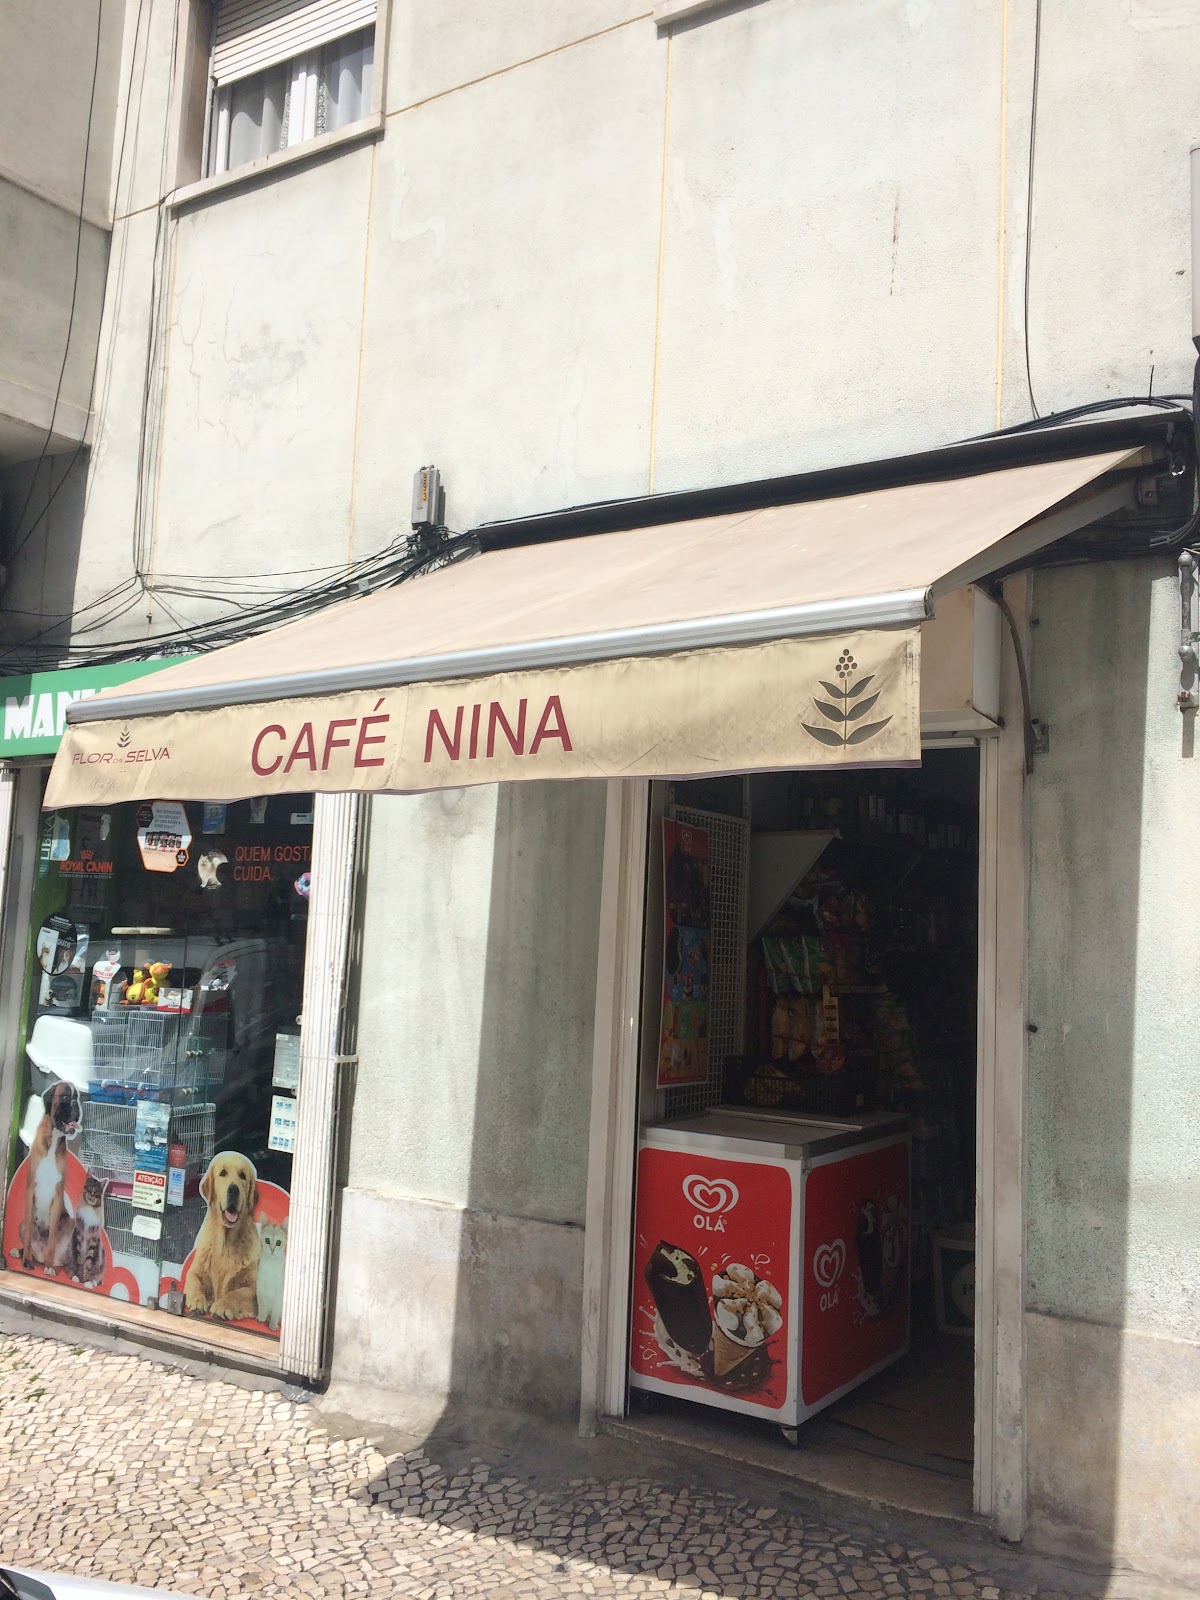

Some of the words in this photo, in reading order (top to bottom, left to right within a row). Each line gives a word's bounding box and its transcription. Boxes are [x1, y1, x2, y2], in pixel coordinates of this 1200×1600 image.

[4, 689, 96, 740] MAN
[251, 698, 390, 776] CAFÉ
[424, 695, 573, 763] NINA
[72, 752, 113, 766] FLOR
[125, 747, 170, 763] SELVA
[40, 814, 56, 860] LIBRA
[235, 846, 271, 862] QUEM
[274, 846, 312, 862] GOST
[59, 860, 85, 873] ROYAL
[86, 861, 113, 874] CANIN
[233, 866, 271, 881] CUIDA
[137, 1174, 163, 1186] ATENÇÃO
[693, 1214, 725, 1233] OLÁ
[820, 1284, 839, 1312] OLÁ
